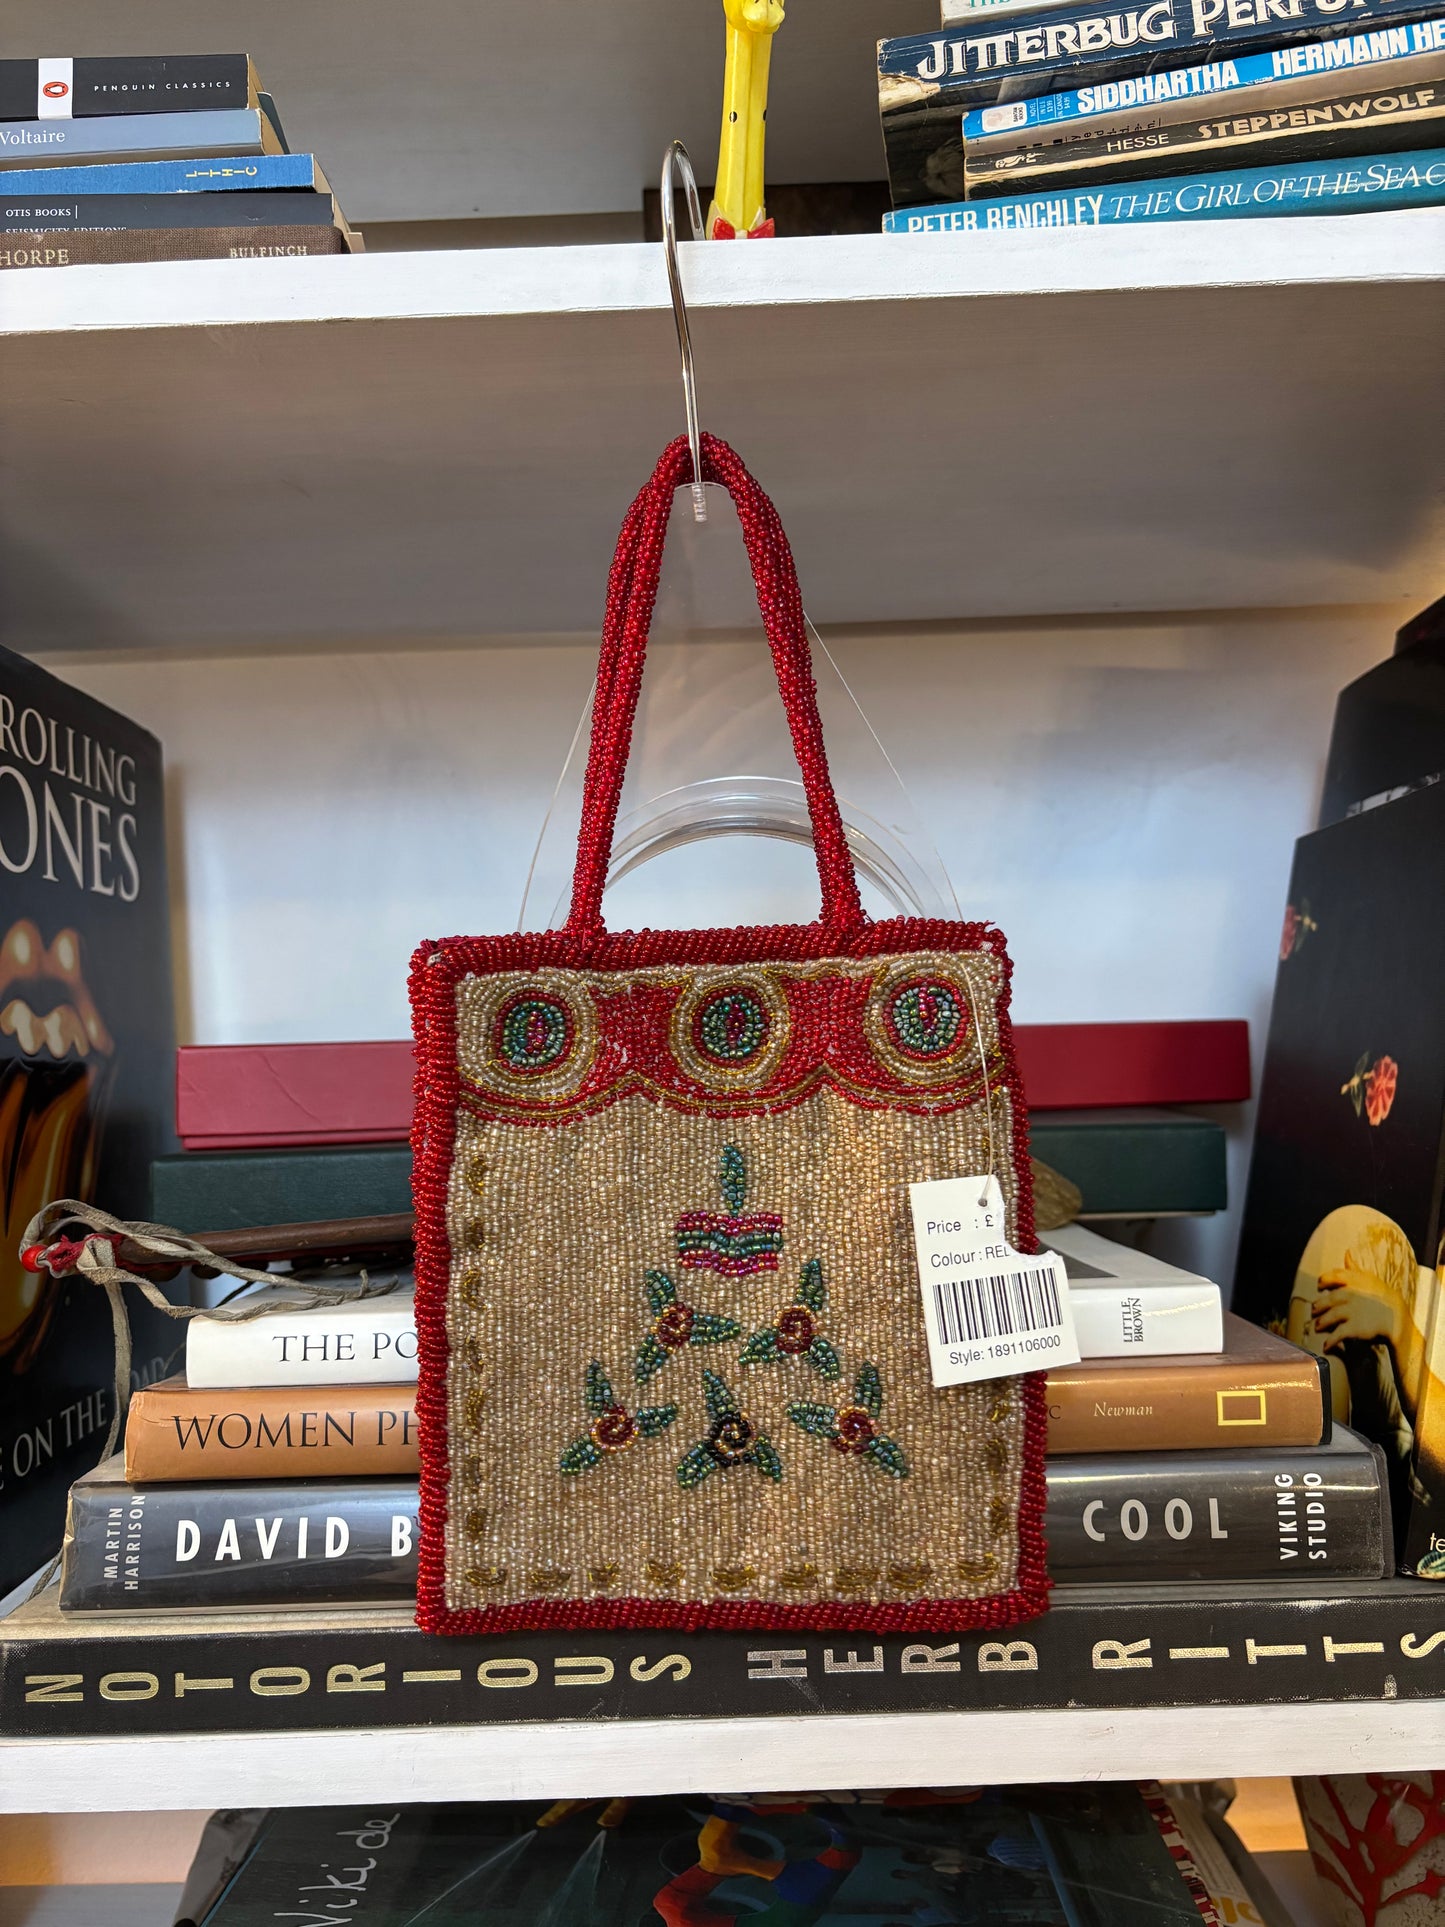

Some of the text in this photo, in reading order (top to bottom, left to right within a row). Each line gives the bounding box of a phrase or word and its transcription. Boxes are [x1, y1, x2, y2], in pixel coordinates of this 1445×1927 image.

[916, 1, 1176, 80] JITTERBUG
[94, 81, 232, 92] PENGUIN CLASSICS
[1077, 60, 1240, 113] SIDDHARTHA
[1271, 27, 1409, 77] HERMANN
[0, 130, 66, 146] Voltaire
[1106, 133, 1169, 152] HESSE
[1198, 89, 1435, 139] STEPPENWOLF
[5, 207, 71, 217] OTIS BOOKS
[987, 194, 1103, 230] BENCHLEY
[1110, 191, 1172, 219] THE
[1175, 183, 1250, 212] GIRL
[1253, 177, 1296, 203] OF
[1299, 171, 1362, 198] THE
[1364, 164, 1421, 191] SEA
[0, 249, 70, 266] HORPE
[230, 245, 308, 259] BULFINCH
[0, 693, 136, 806] ROLLING
[0, 765, 140, 902] ONES
[927, 1219, 962, 1236] Price
[985, 1214, 994, 1228] £
[1131, 1297, 1144, 1342] BROWN
[273, 1331, 419, 1362] THE PO
[949, 1334, 1061, 1366] Style: 1891106000
[13, 1417, 53, 1477] ON
[60, 1388, 107, 1448] THE
[171, 1410, 356, 1450] WOMEN
[1093, 1402, 1153, 1417] Newman
[175, 1516, 351, 1563] DAVID
[1082, 1497, 1229, 1543] COOL
[1274, 1473, 1299, 1561] VIKING
[1303, 1472, 1328, 1561] STUDIO
[104, 1508, 123, 1579] MARTIN
[124, 1495, 146, 1590] HARRISON
[25, 1630, 1445, 1703] NOTORIOUS HERB RITTS
[335, 1812, 400, 1850] de
